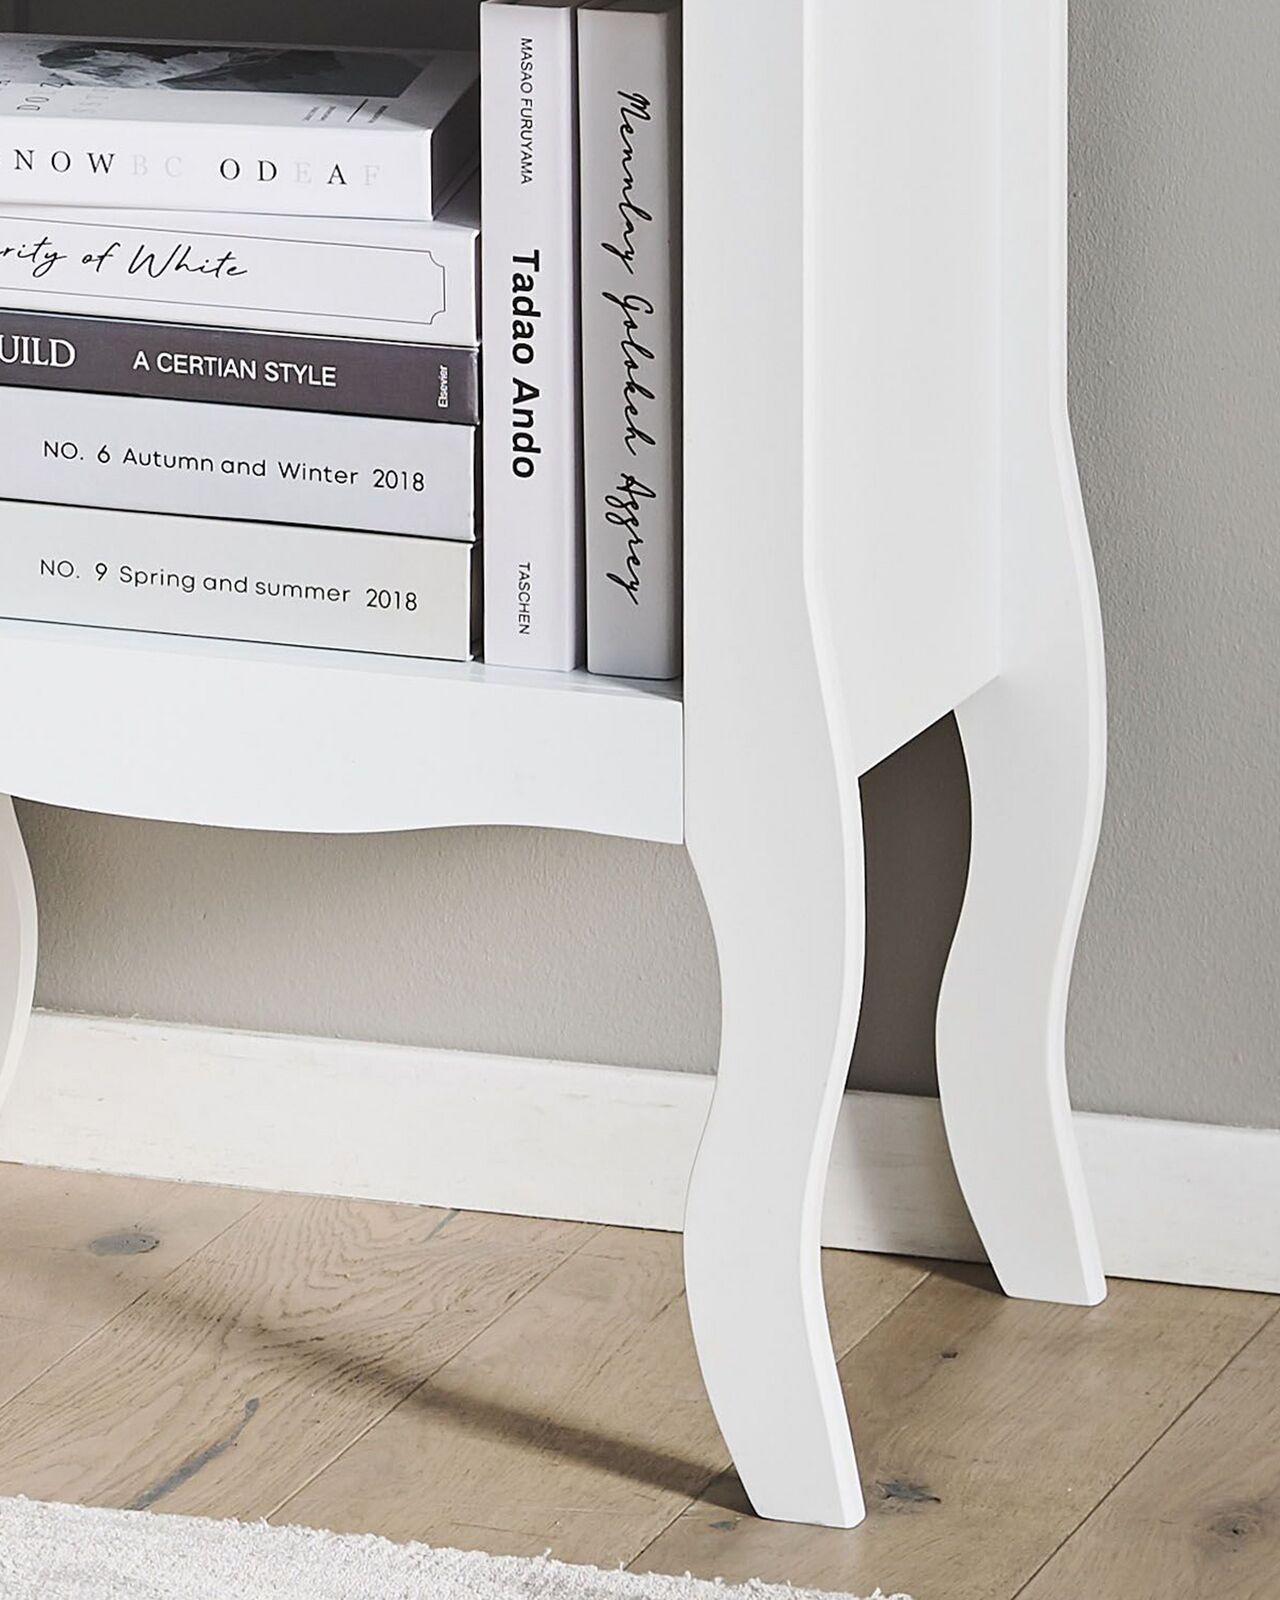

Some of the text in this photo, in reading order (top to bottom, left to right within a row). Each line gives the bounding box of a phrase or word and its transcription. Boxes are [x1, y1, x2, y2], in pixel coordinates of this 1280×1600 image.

[520, 37, 533, 185] MASAO FURUYAMA
[81, 241, 121, 273] of
[127, 244, 248, 279] White
[133, 351, 150, 371] A
[156, 352, 257, 380] CERTIAN
[264, 362, 337, 388] STYLE
[511, 249, 542, 479] Tadao Ando
[43, 440, 85, 461] NO.
[97, 444, 111, 464] 6
[122, 447, 214, 473] Autumn
[220, 459, 267, 477] and
[277, 461, 359, 486] Winter
[372, 468, 426, 492] 2018
[40, 558, 81, 580] NO.
[94, 562, 108, 582] 9
[119, 565, 196, 593] Spring
[202, 575, 249, 594] and
[254, 581, 352, 603] summer
[365, 588, 419, 612] 2018
[518, 562, 531, 635] TASCHEN
